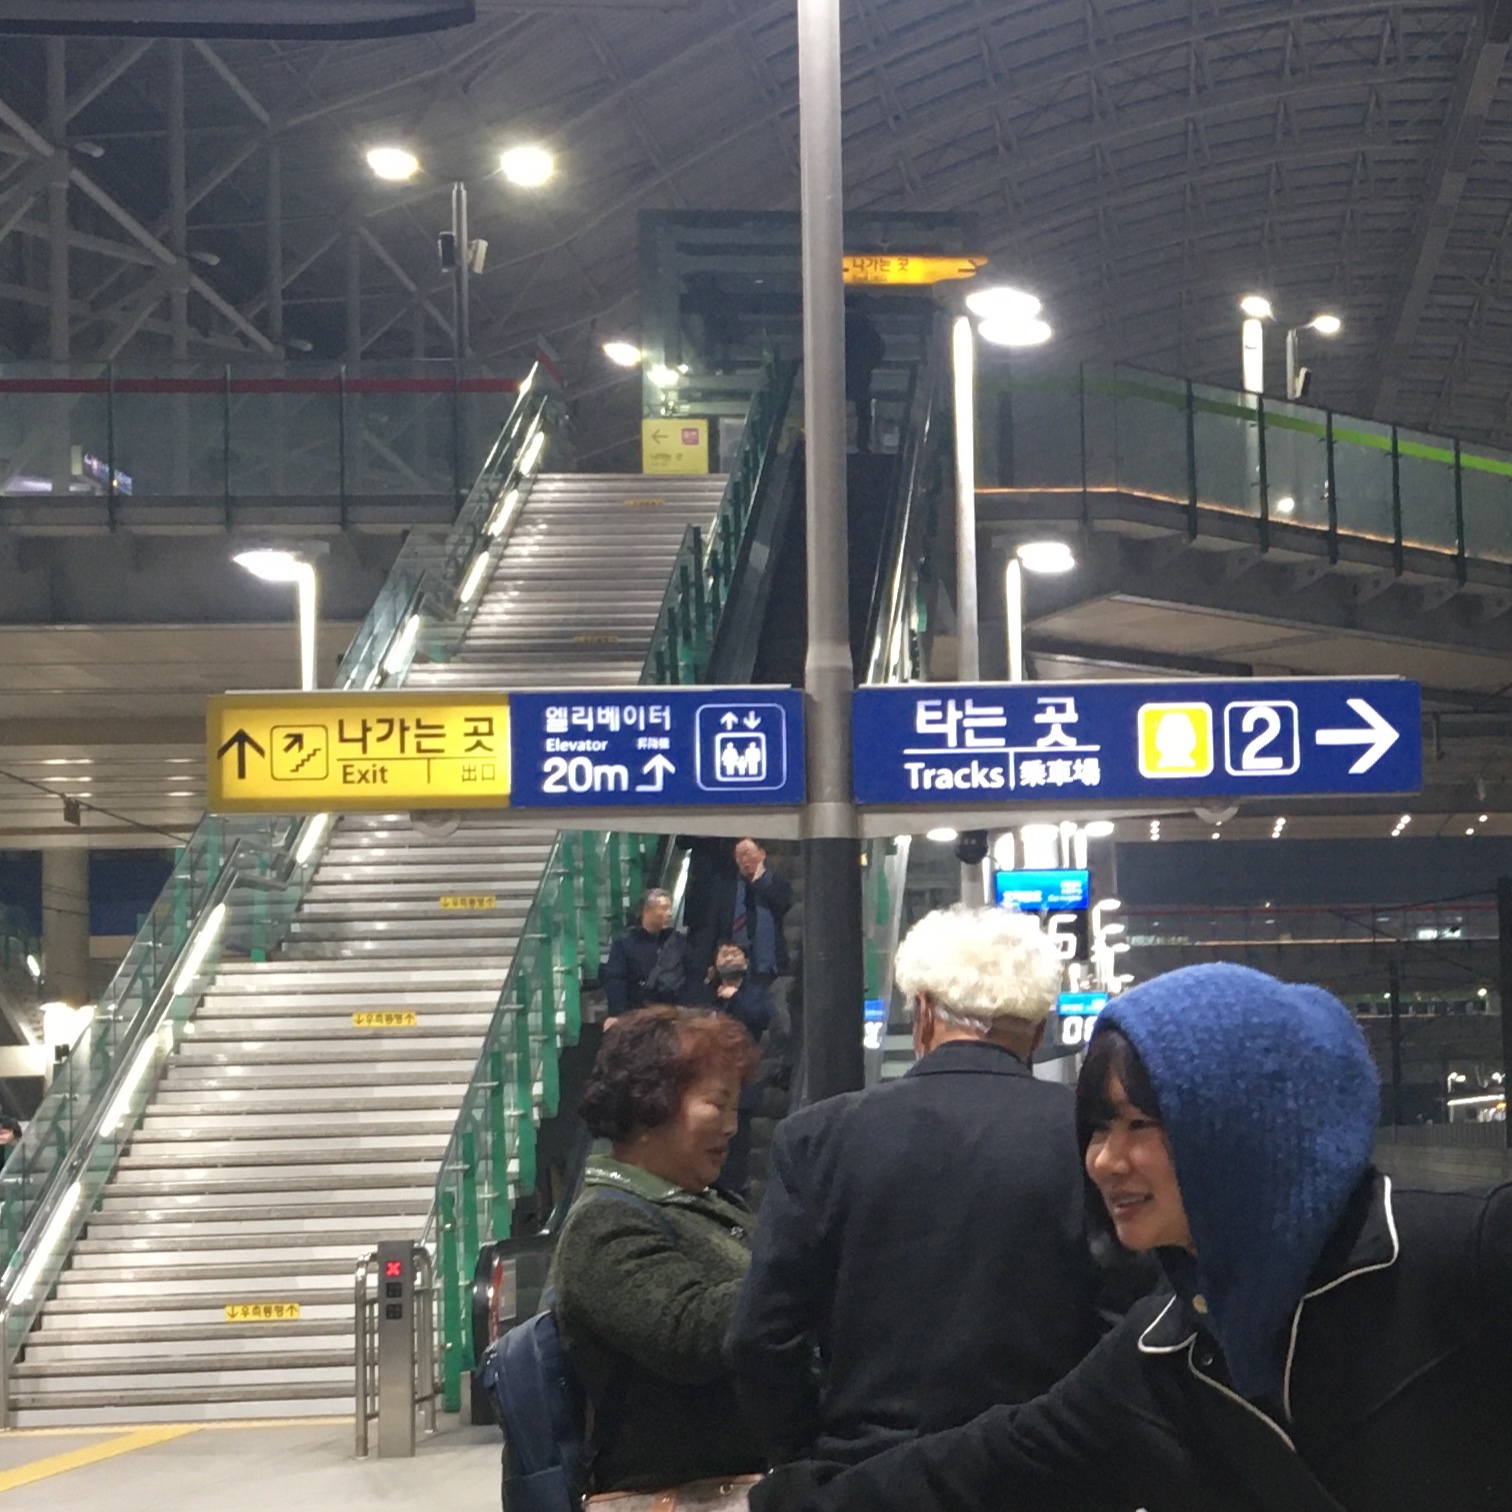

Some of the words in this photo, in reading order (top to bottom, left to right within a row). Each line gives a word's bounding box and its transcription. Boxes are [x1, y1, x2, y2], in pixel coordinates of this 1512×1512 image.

[853, 258, 890, 271] 나가는
[545, 705, 671, 733] 엘리베이터
[916, 699, 1007, 747] 타는
[1034, 697, 1078, 747] 곳
[338, 718, 446, 755] 나가는
[463, 717, 494, 752] 곳
[545, 738, 608, 752] Elevator
[1242, 706, 1283, 770] 2
[342, 764, 388, 784] Exit
[462, 763, 495, 782] 出口
[543, 756, 628, 793] 20m
[904, 760, 1005, 789] Tracks
